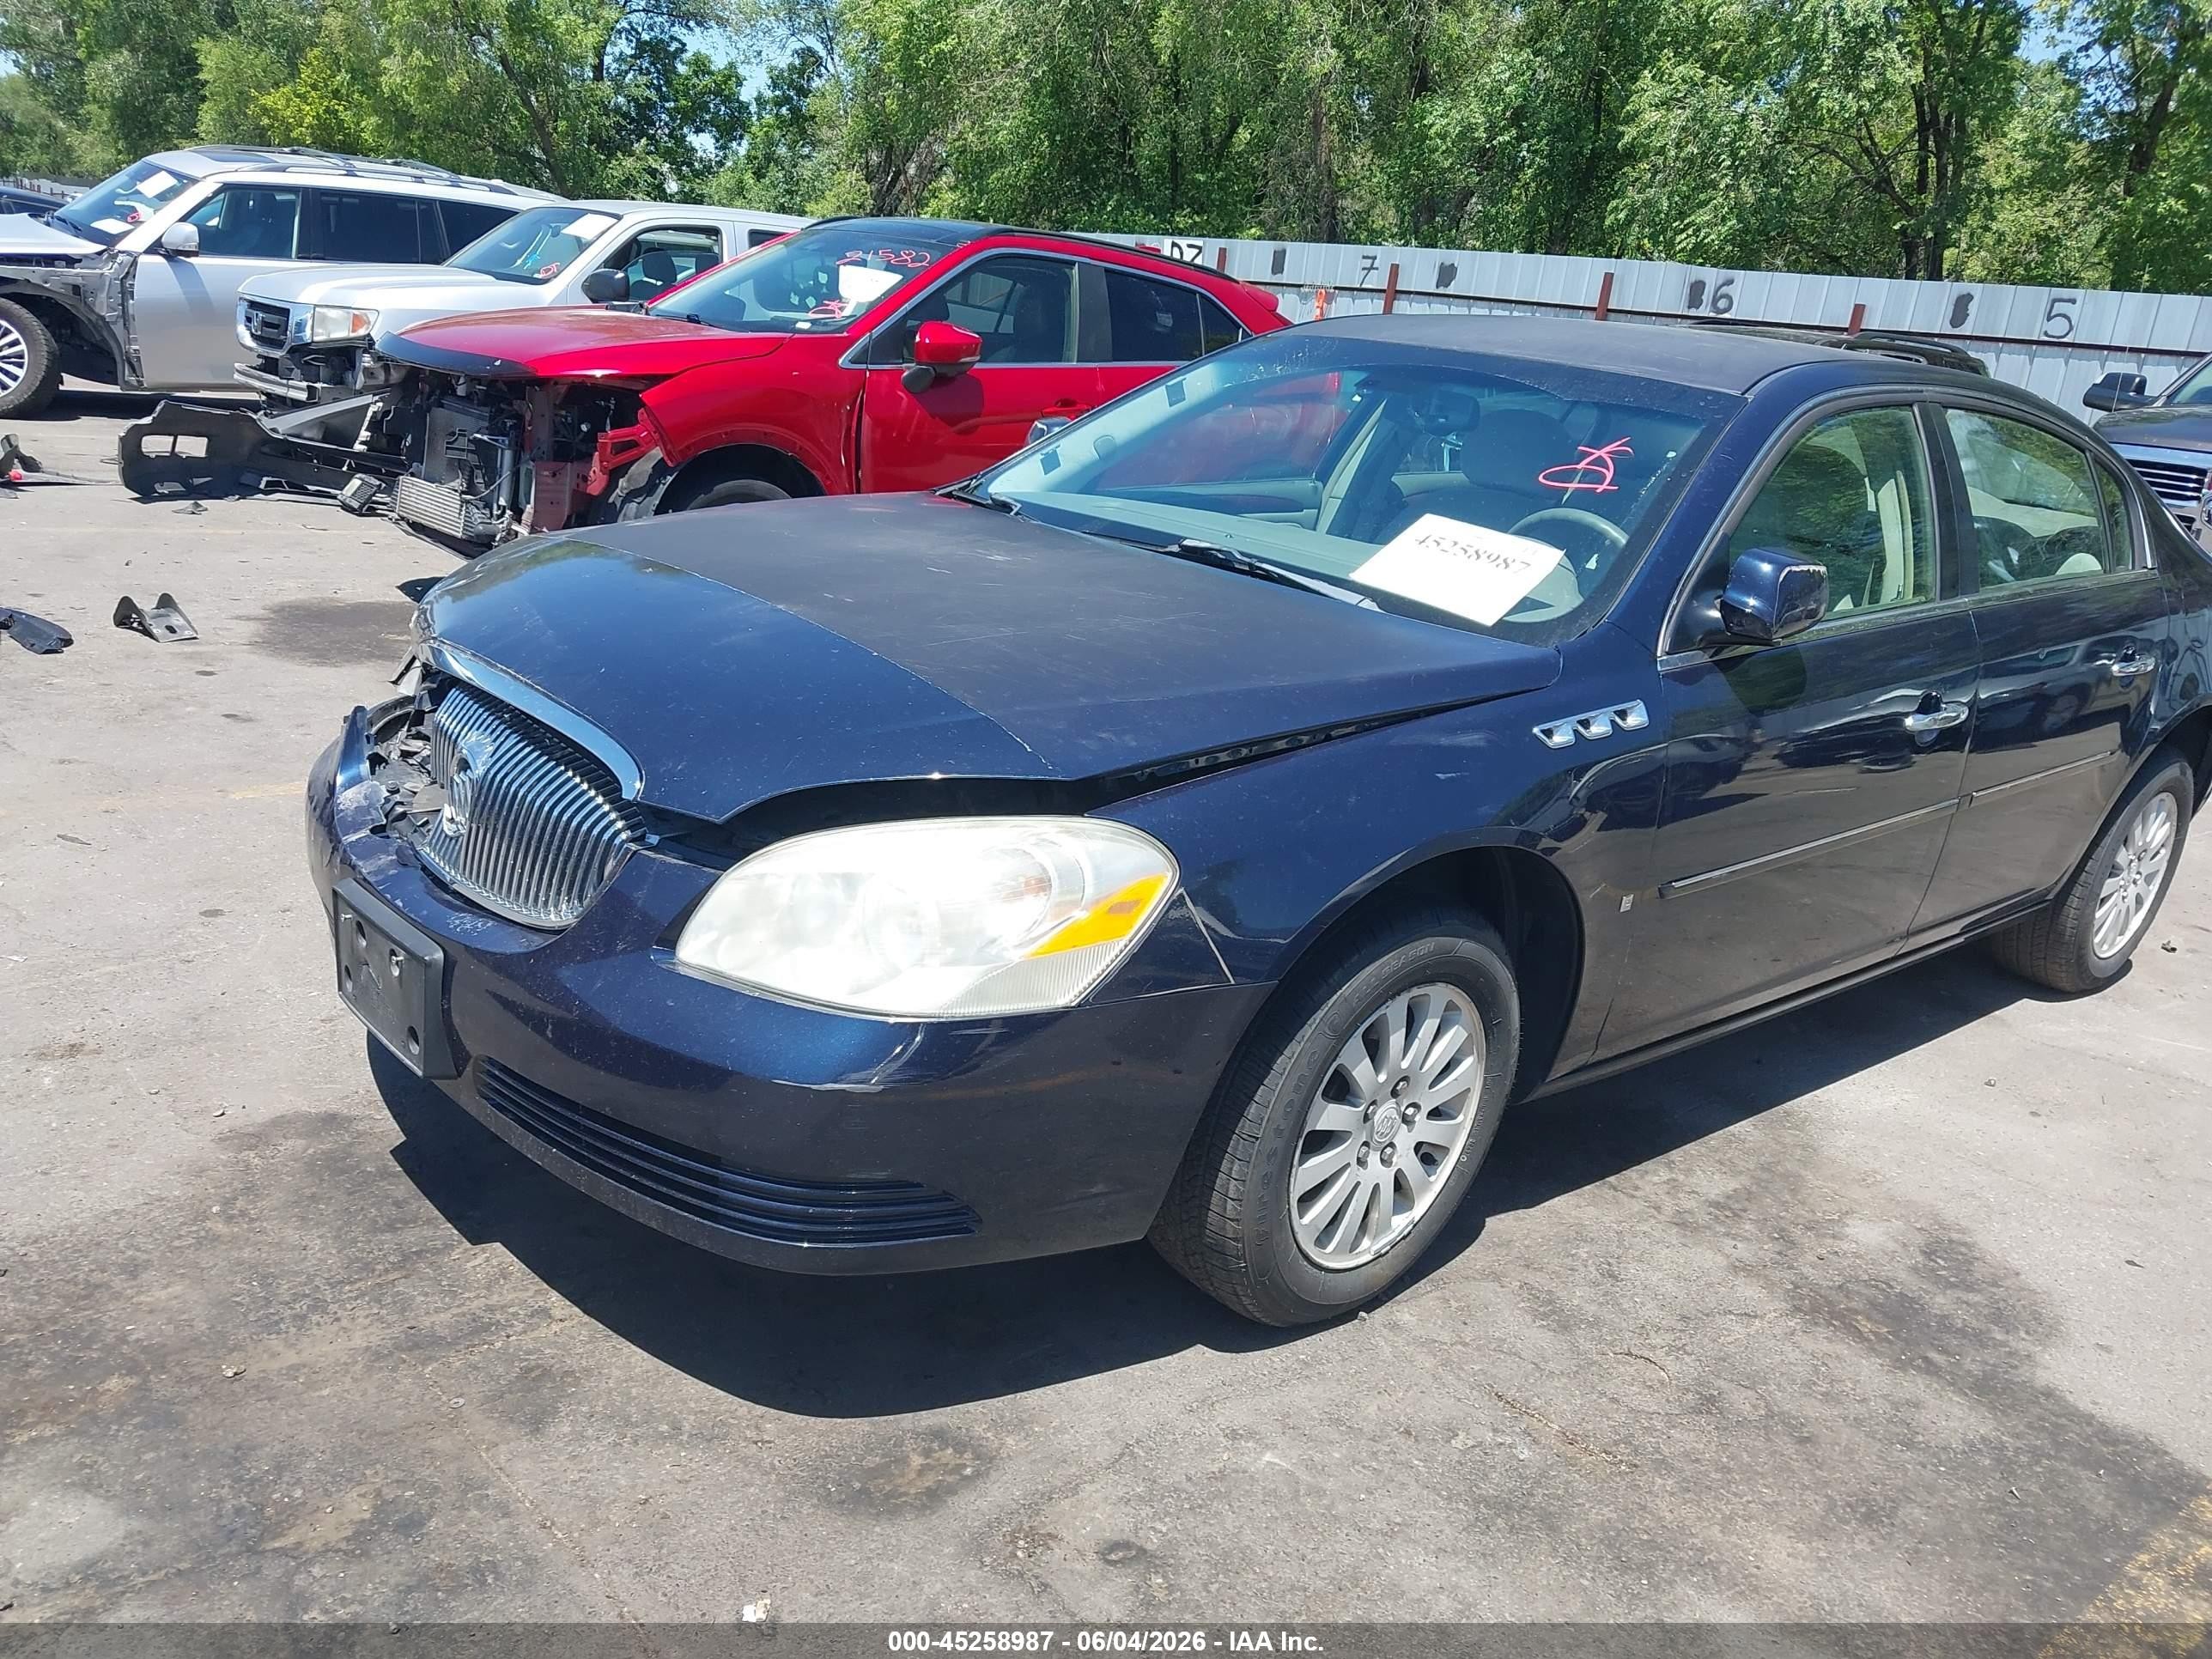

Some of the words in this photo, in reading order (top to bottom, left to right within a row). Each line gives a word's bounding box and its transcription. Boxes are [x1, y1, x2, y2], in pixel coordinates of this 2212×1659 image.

[835, 248, 931, 269] 21582
[1359, 254, 1379, 288] 7
[1712, 278, 1735, 315] 6
[2044, 297, 2077, 339] 5
[1414, 534, 1532, 574] 45258987
